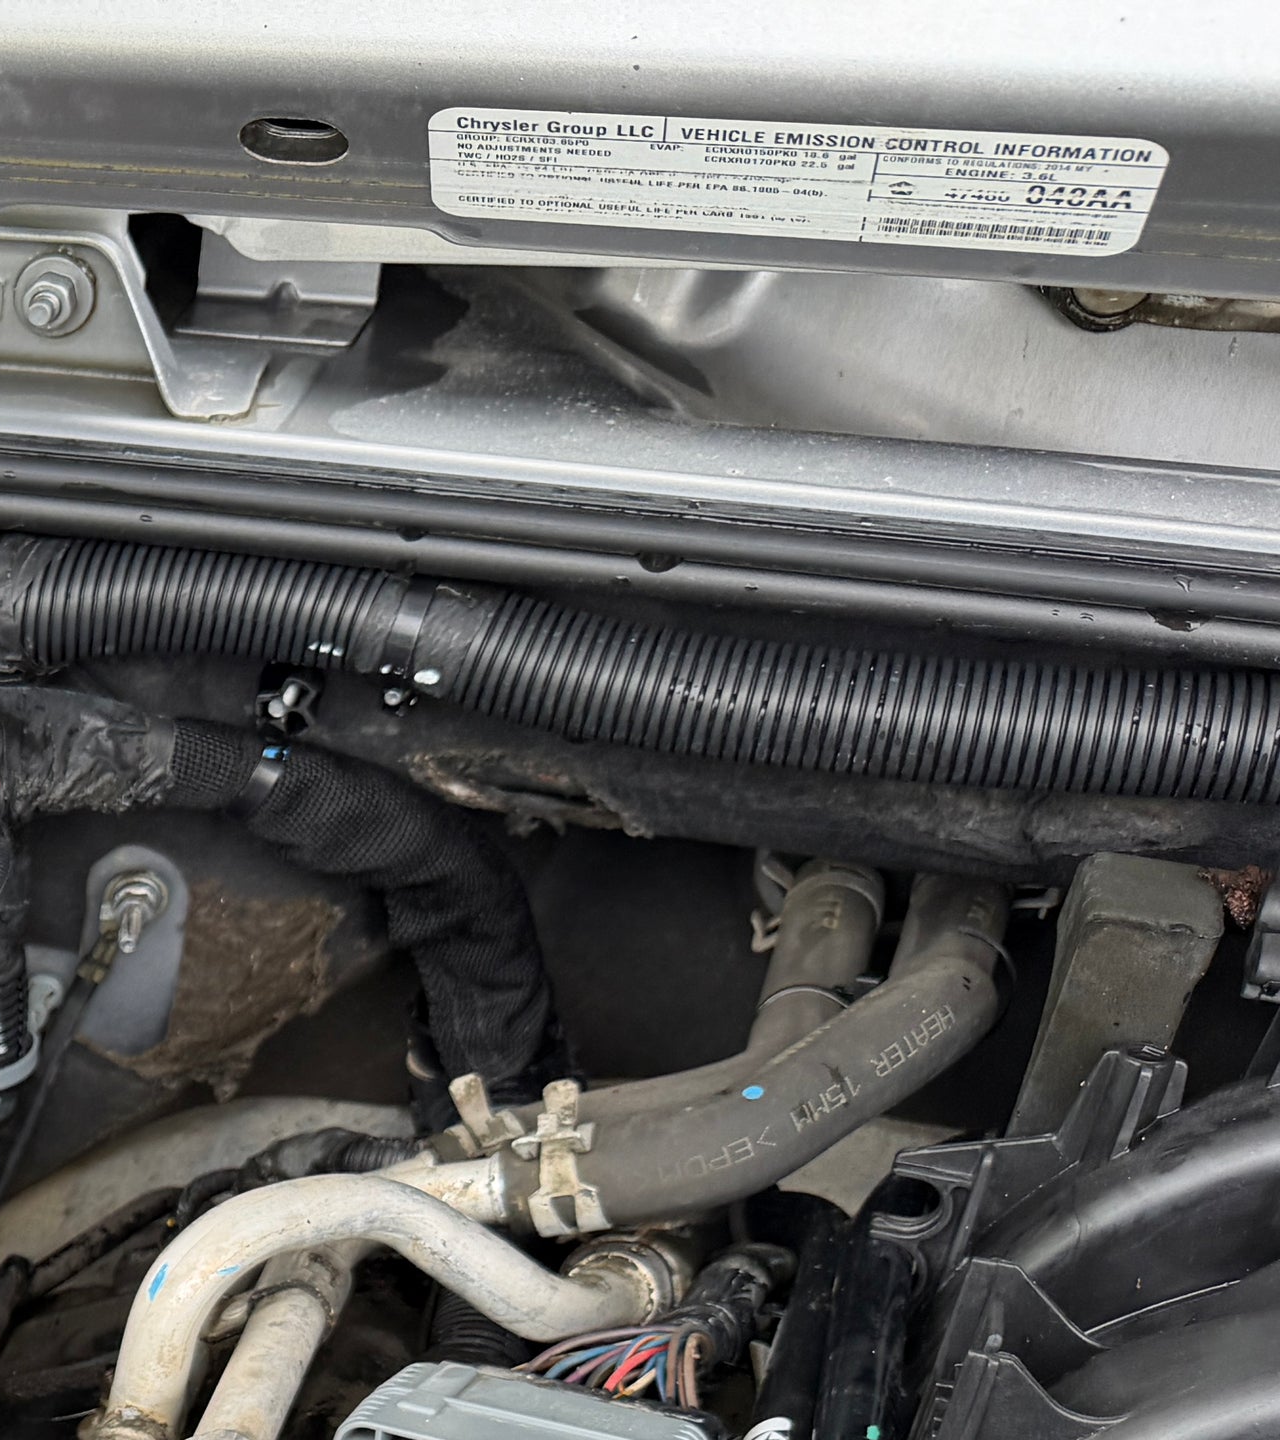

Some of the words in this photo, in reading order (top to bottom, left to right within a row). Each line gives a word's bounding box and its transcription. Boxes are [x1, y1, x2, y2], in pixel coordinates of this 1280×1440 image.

[456, 116, 539, 133] Chrysler
[547, 120, 607, 137] Group
[617, 124, 654, 138] LLC
[457, 142, 473, 150] NO
[477, 143, 562, 155] ADJUSTMENTS
[566, 147, 612, 157] NEEDED
[681, 127, 765, 144] VEHICLE
[774, 132, 875, 150] EMISSION
[885, 137, 984, 155] CONTROL
[994, 143, 1153, 163] INFORMATION
[458, 151, 482, 160] TWC
[839, 153, 857, 162] gal
[883, 154, 942, 166] CONFORMS
[837, 162, 855, 171] gal
[945, 167, 1015, 180] ENGINE:
[1022, 171, 1058, 182] 3.6L
[706, 183, 728, 191] EPA
[458, 194, 515, 205] CERTIFIED
[521, 197, 534, 206] TO
[538, 199, 594, 209] OPTIONAL
[598, 202, 641, 213] USEFUL
[870, 1004, 956, 1078] HEATER
[790, 1075, 862, 1132] 15MM
